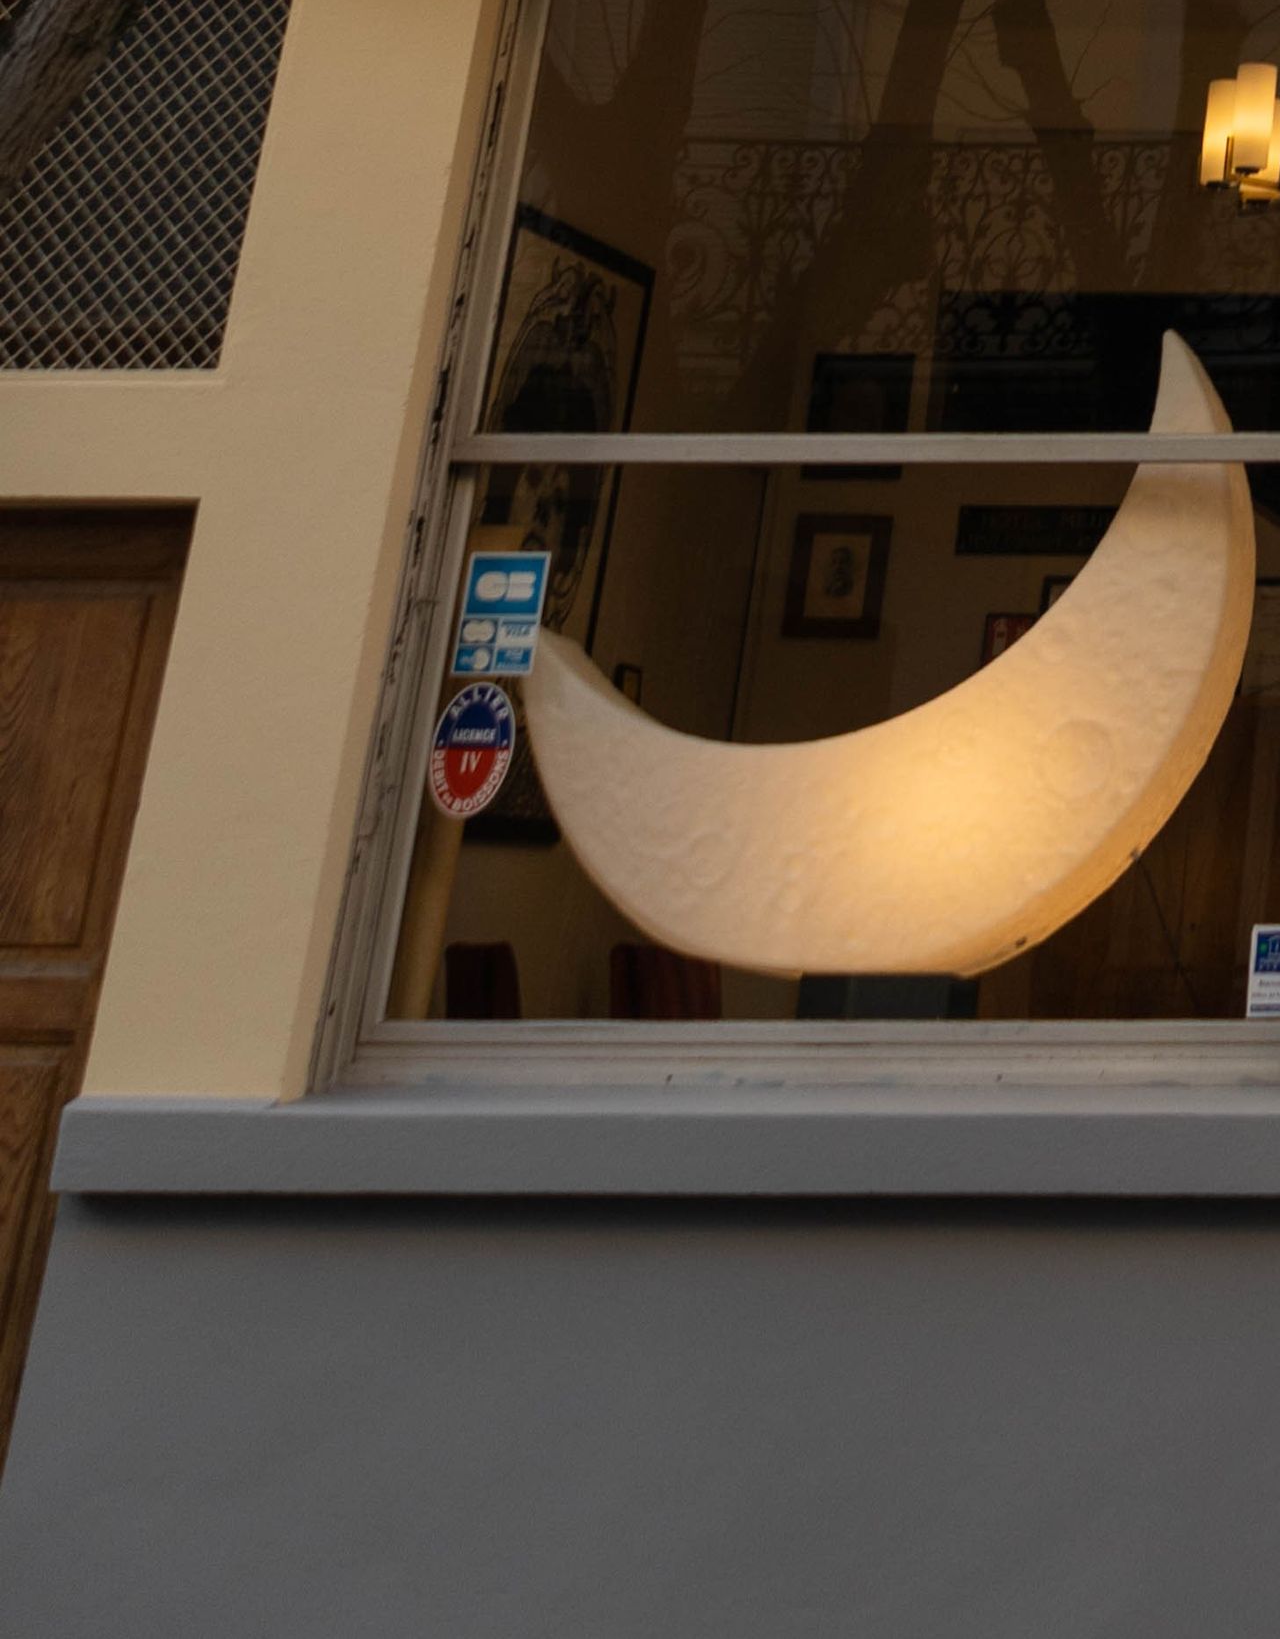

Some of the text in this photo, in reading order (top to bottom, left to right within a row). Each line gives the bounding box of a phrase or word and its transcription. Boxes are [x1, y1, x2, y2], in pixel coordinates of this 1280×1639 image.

[450, 685, 510, 719] ALLIER
[452, 727, 498, 743] LICENCE
[459, 750, 482, 774] IV
[452, 750, 509, 812] BOISSONS
